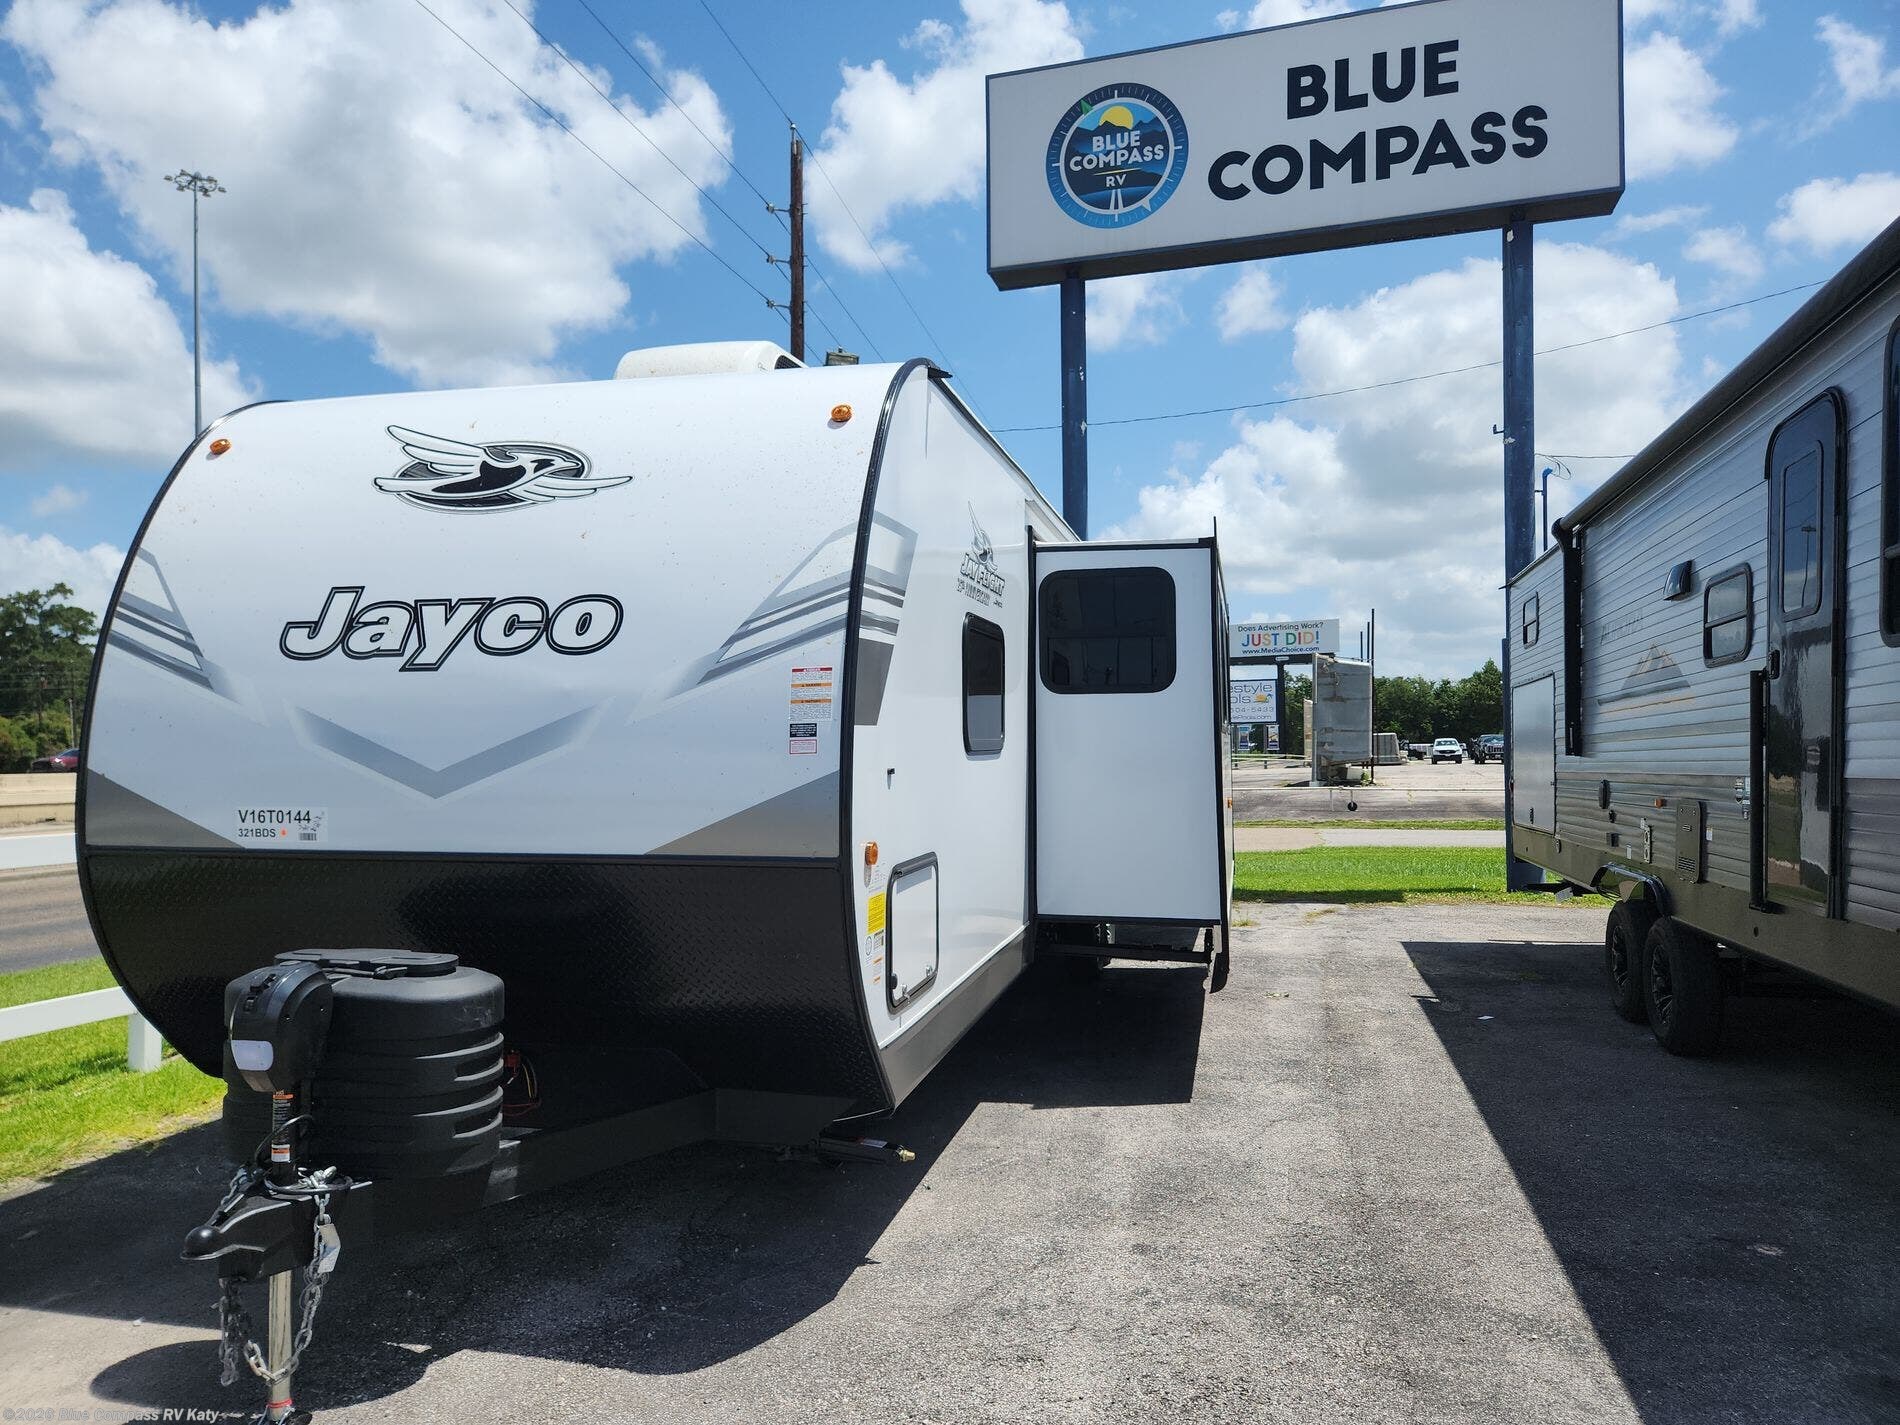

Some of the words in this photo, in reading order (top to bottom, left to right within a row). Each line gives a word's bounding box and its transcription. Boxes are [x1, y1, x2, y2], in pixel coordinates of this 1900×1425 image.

[1287, 39, 1459, 120] BLUE
[1092, 130, 1141, 152] BLUE
[1069, 144, 1164, 172] COMPASS
[1208, 105, 1548, 201] COMPASS
[1106, 174, 1126, 187] RV
[279, 585, 624, 672] Jayco
[1257, 623, 1299, 631] Advertising
[1301, 621, 1323, 629] Work?
[1242, 633, 1279, 646] JUST
[1285, 630, 1320, 645] DID!
[1242, 646, 1320, 654] www.MediaChoice.com
[238, 809, 311, 824] V16T0144
[238, 828, 276, 838] 321BDS
